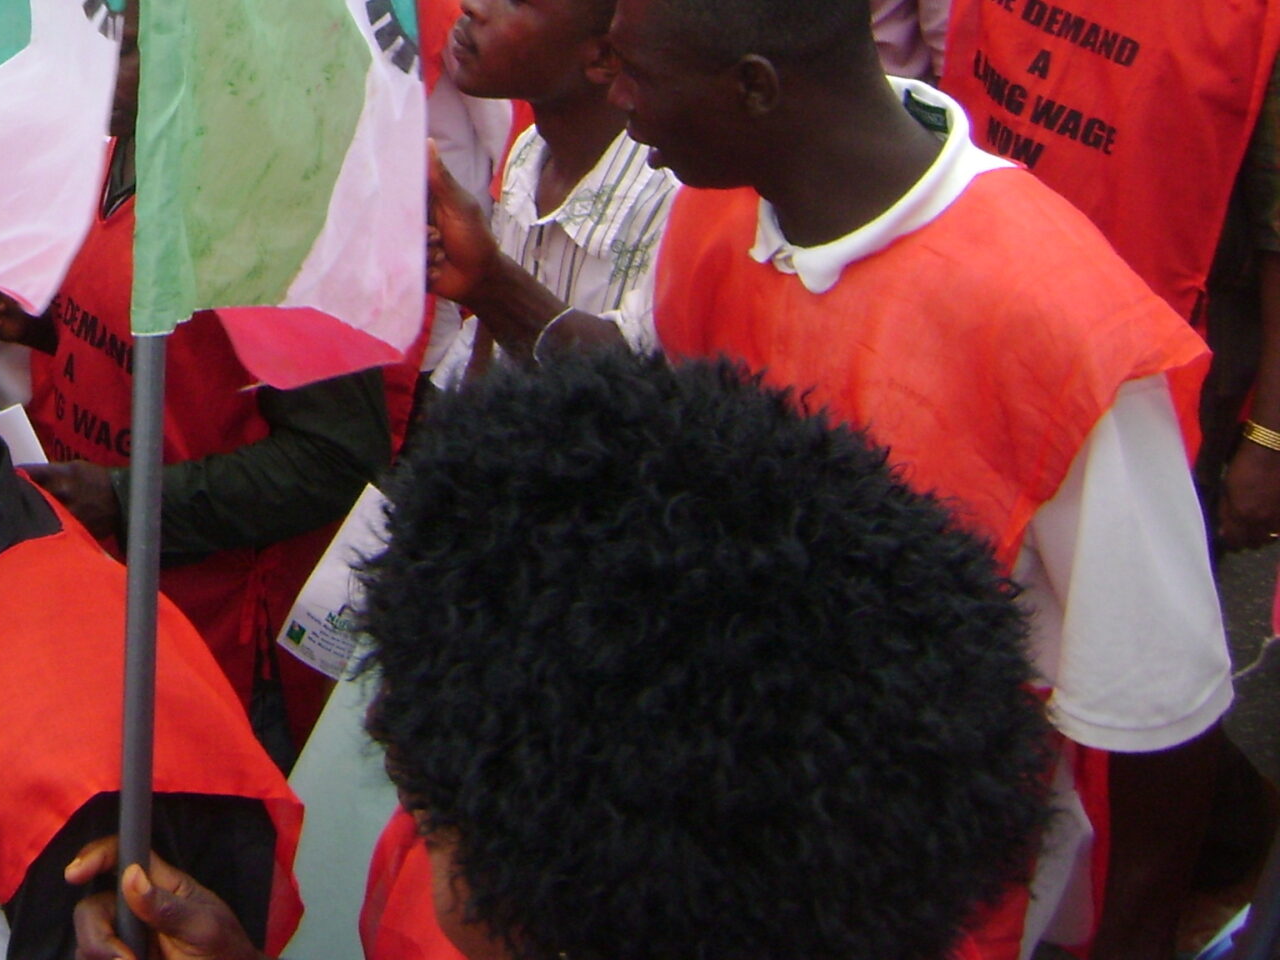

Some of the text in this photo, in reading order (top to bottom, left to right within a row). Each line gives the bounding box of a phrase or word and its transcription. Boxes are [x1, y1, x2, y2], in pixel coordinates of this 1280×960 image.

[1026, 48, 1052, 81] A
[987, 114, 1046, 170] NOW
[1030, 94, 1118, 156] WAGE
[63, 351, 75, 384] A
[72, 402, 133, 458] WAG
